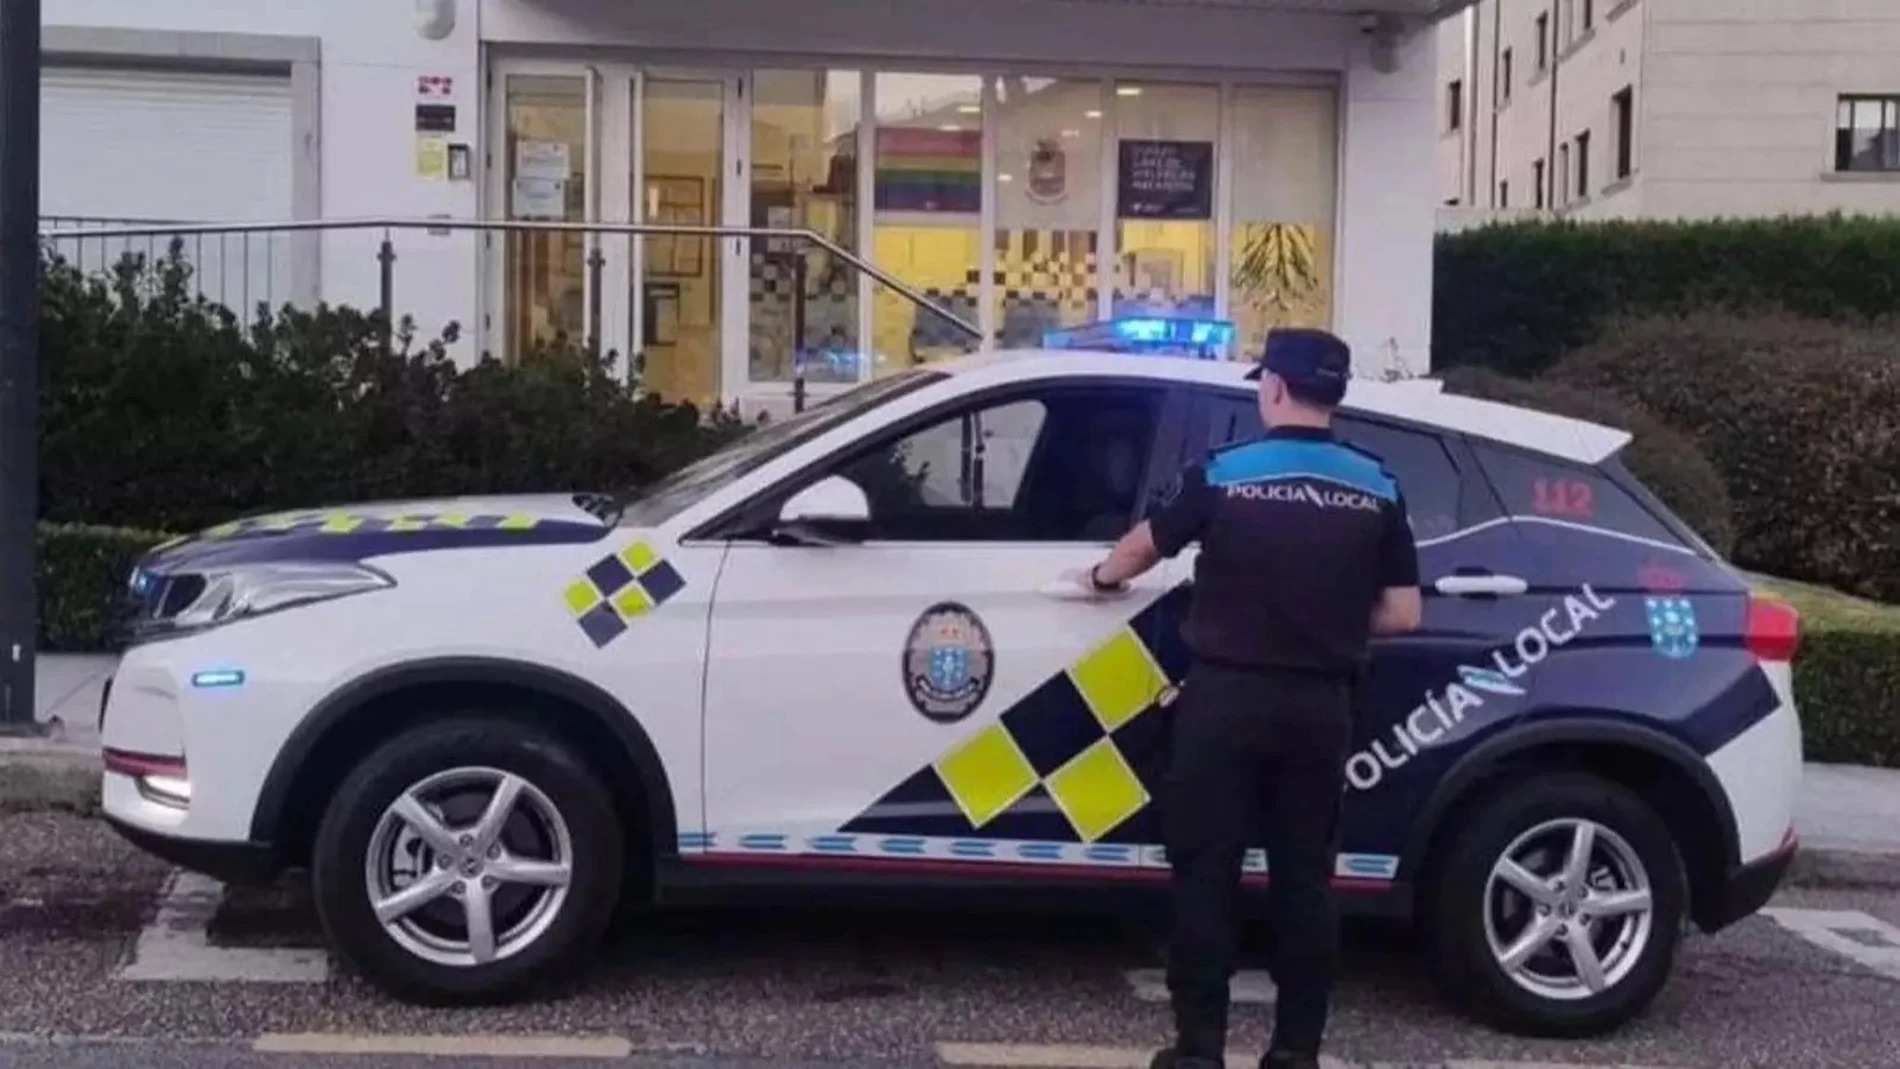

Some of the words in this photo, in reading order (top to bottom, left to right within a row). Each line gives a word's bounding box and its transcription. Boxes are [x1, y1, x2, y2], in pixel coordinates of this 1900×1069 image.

[1324, 489, 1381, 513] LOCAL
[1533, 478, 1594, 517] 112
[1343, 681, 1484, 791] OLICÍA
[1492, 582, 1617, 677] LOCAL
